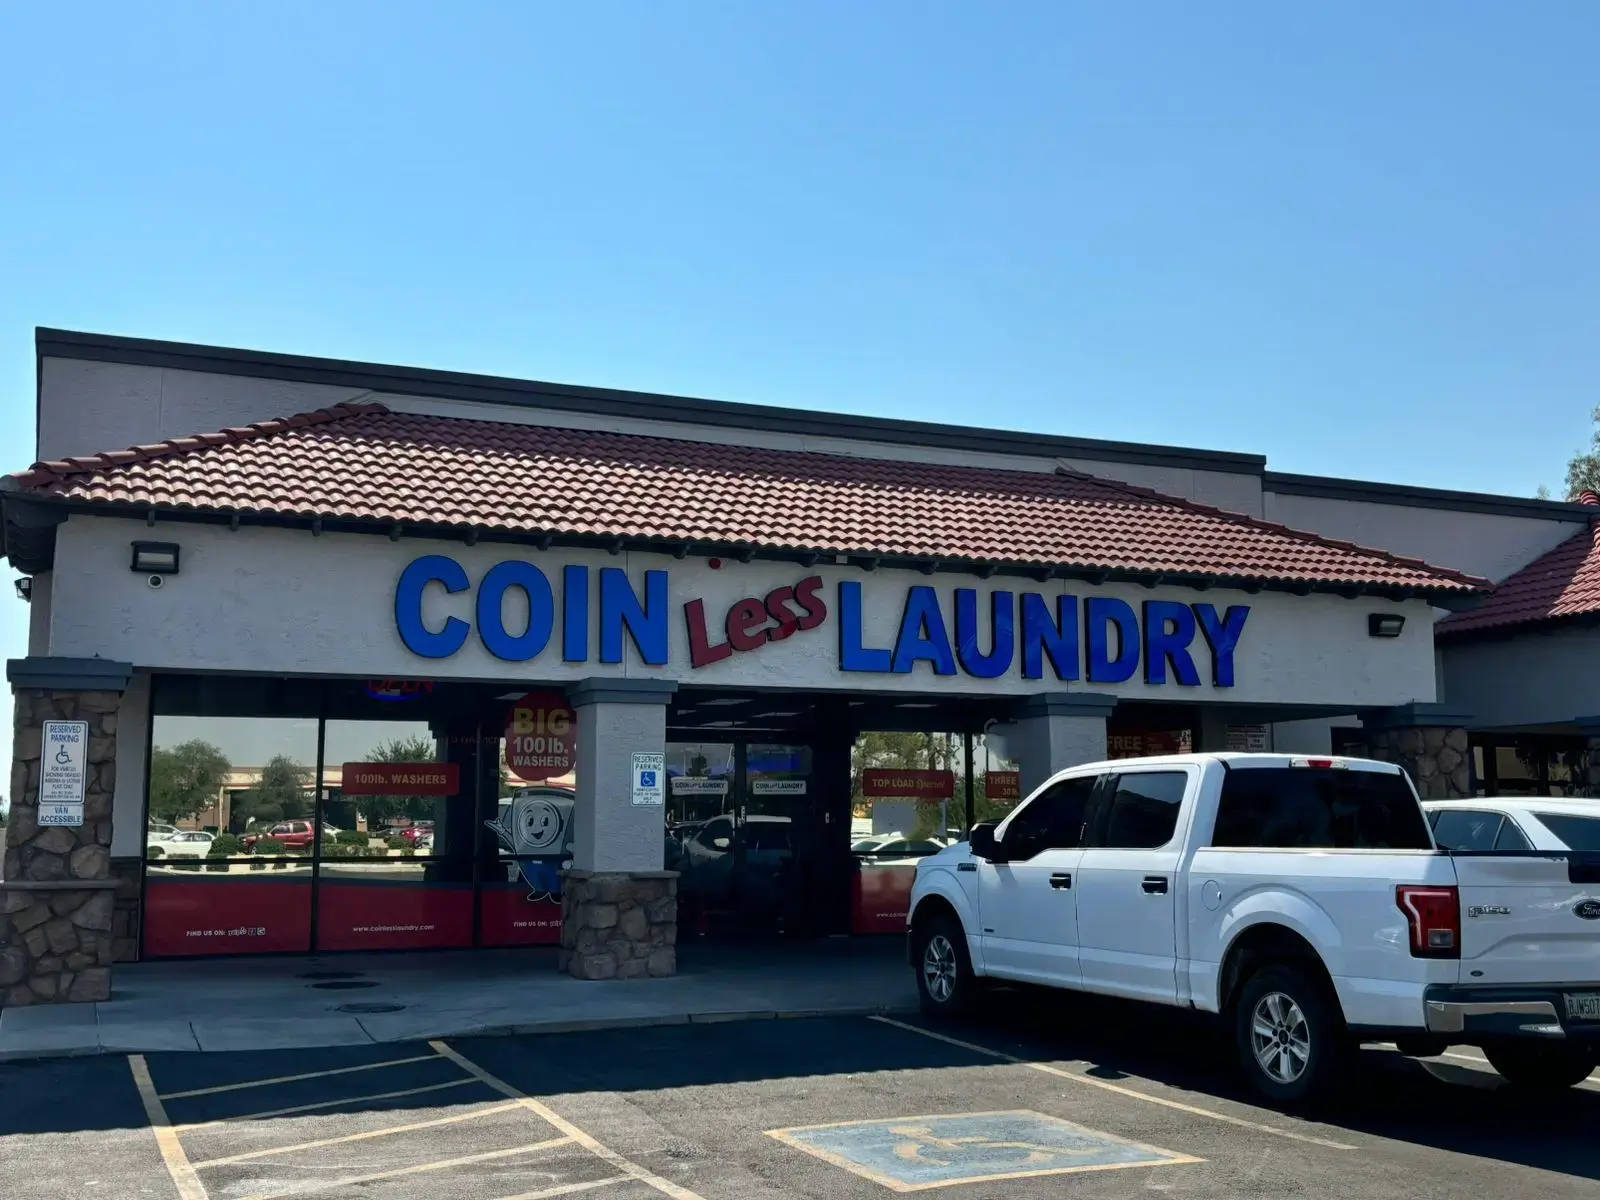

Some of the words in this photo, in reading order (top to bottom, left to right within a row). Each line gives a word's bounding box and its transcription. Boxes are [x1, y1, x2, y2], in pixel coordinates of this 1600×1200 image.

[395, 555, 668, 665] COIN
[684, 576, 827, 669] Less
[838, 581, 1251, 687] LAUNDRY
[514, 708, 570, 735] BIG
[50, 725, 81, 734] RESERVED
[50, 734, 80, 743] PARKING
[513, 755, 569, 767] WASHERS
[634, 755, 663, 763] RESERVED
[635, 763, 662, 771] PARKING
[354, 773, 388, 784] 100lb.
[391, 774, 447, 785] WASHERS
[871, 778, 890, 788] TOP
[892, 778, 915, 788] LOAD
[988, 775, 1017, 785] THREE
[40, 815, 82, 823] ACCESSIBLE
